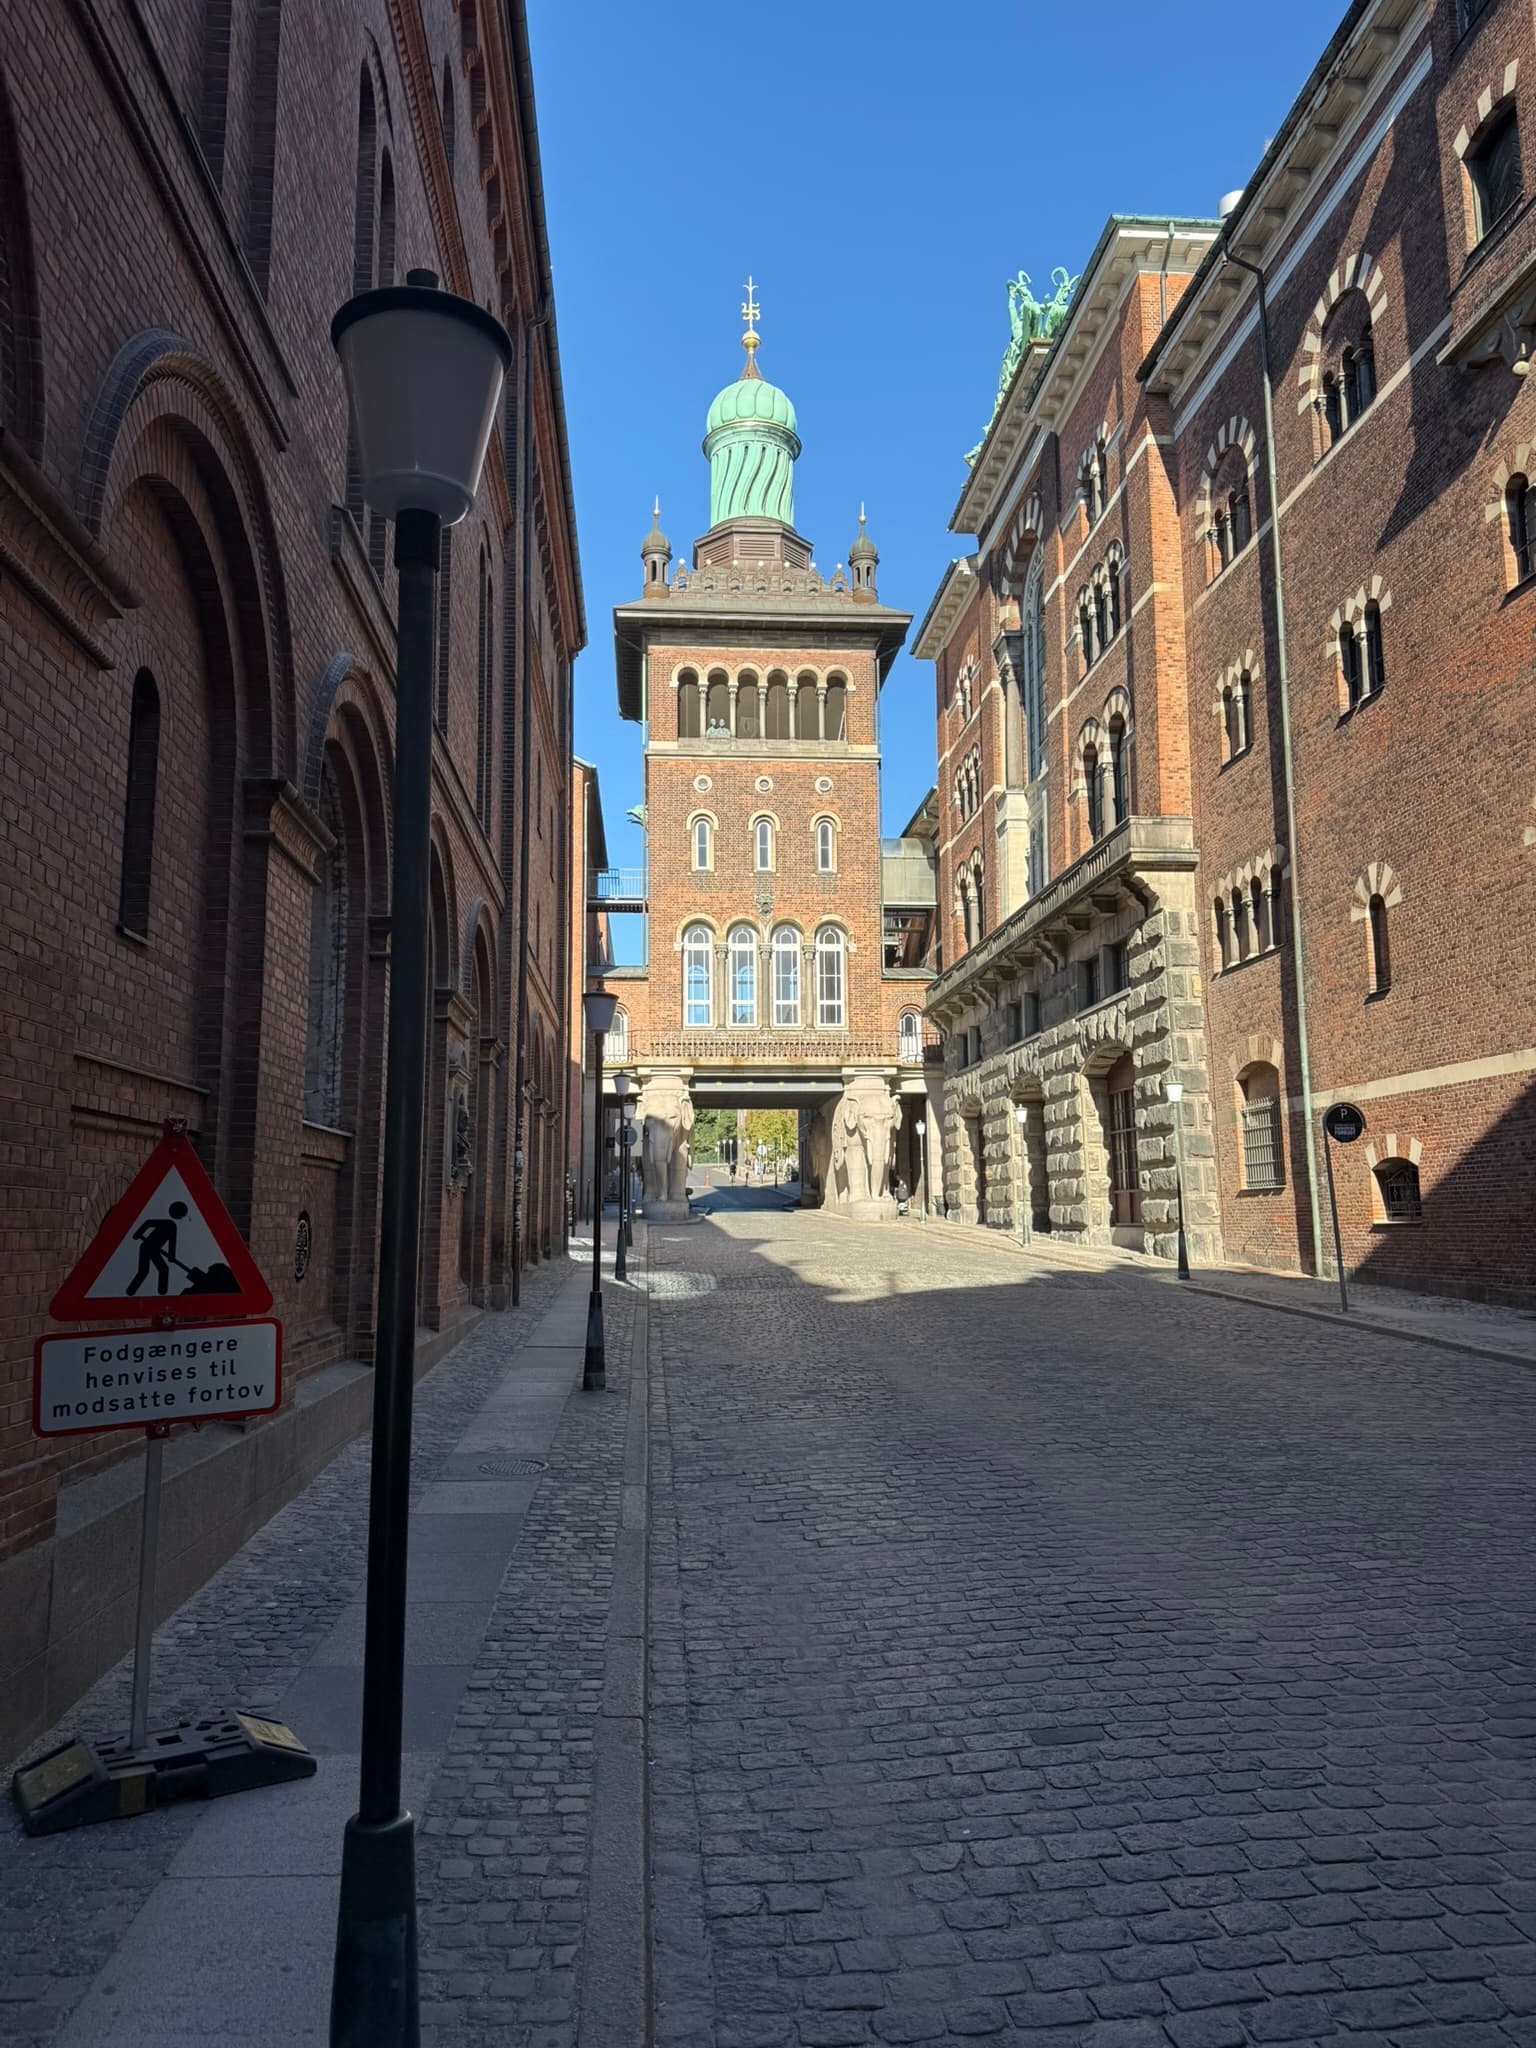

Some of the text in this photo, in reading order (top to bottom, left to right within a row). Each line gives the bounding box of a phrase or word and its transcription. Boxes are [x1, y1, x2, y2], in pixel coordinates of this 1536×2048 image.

[84, 1339, 238, 1363] Fodgængere
[85, 1359, 237, 1389] henvises til
[52, 1383, 264, 1418] modsatte fortov
